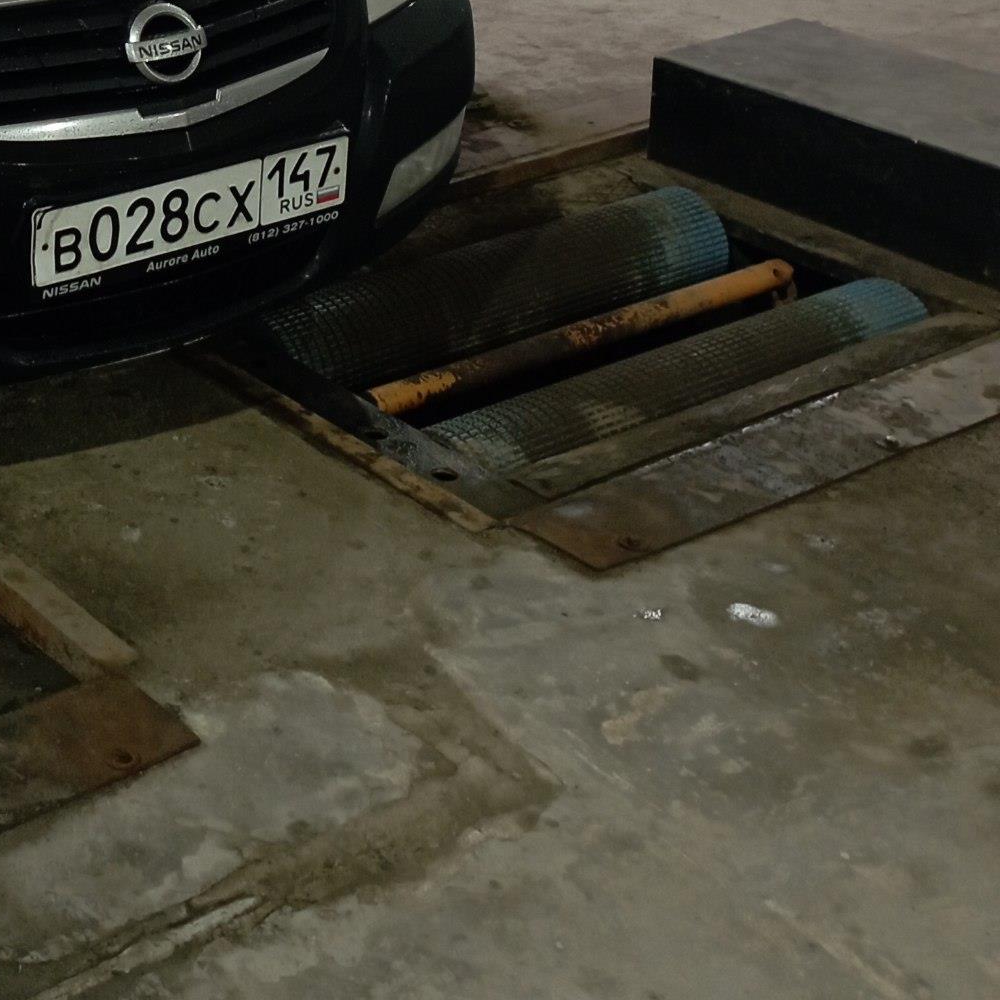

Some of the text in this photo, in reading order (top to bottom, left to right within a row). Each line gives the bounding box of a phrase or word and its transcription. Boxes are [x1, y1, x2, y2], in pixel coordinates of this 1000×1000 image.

[139, 35, 202, 58] NISSAN
[267, 145, 336, 198] 147
[280, 192, 314, 214] RUS
[248, 211, 339, 244] (812) 327-1000
[191, 243, 220, 261] Auto
[42, 276, 101, 299] NISSAN
